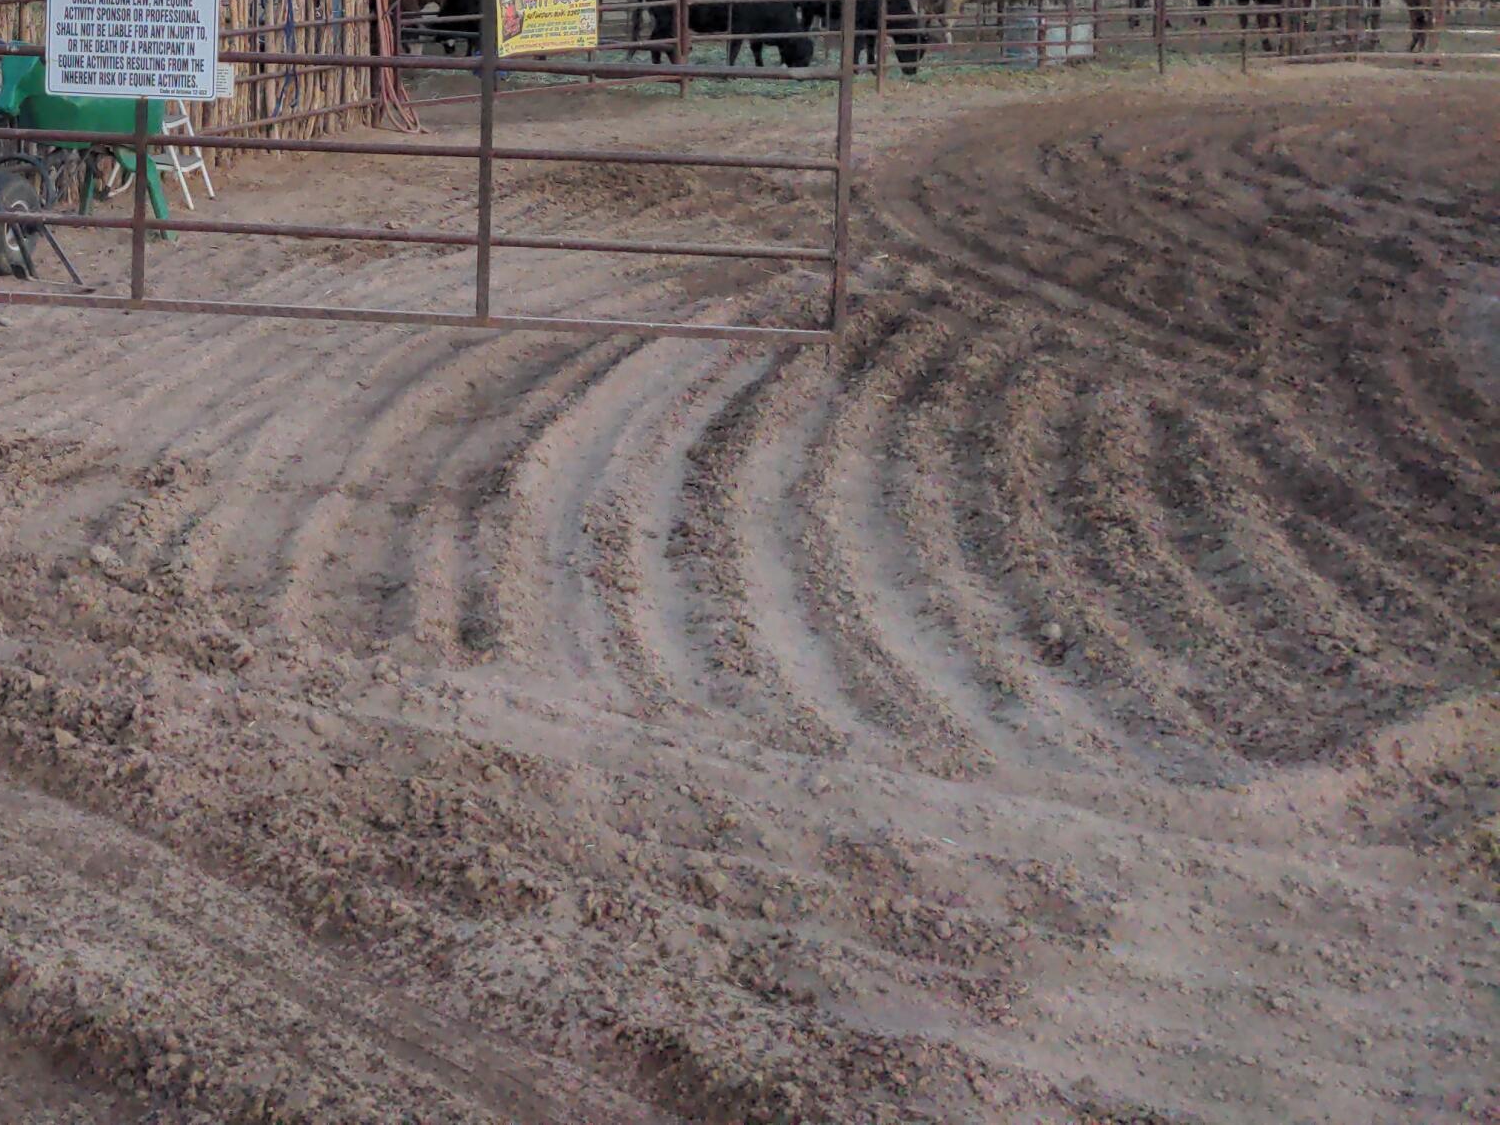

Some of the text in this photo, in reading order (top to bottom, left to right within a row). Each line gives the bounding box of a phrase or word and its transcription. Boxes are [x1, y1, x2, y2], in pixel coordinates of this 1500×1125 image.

[64, 6, 201, 24] ACTIVITY SPONSOR OR PROFESSIONAL
[56, 22, 208, 42] SHALL NOT BE LIABLE FOR ANY INJURY TO,
[67, 38, 196, 56] OR THE DEATH OF A PARTICIPANT IN
[58, 54, 205, 73] EQUINE ACTIVITIES RESULTING FROM THE
[61, 70, 97, 85] INHERENT
[99, 71, 116, 86] RISK
[118, 72, 128, 87] OF
[129, 72, 156, 88] EQUINE
[158, 74, 199, 89] ACTIVITIES.
